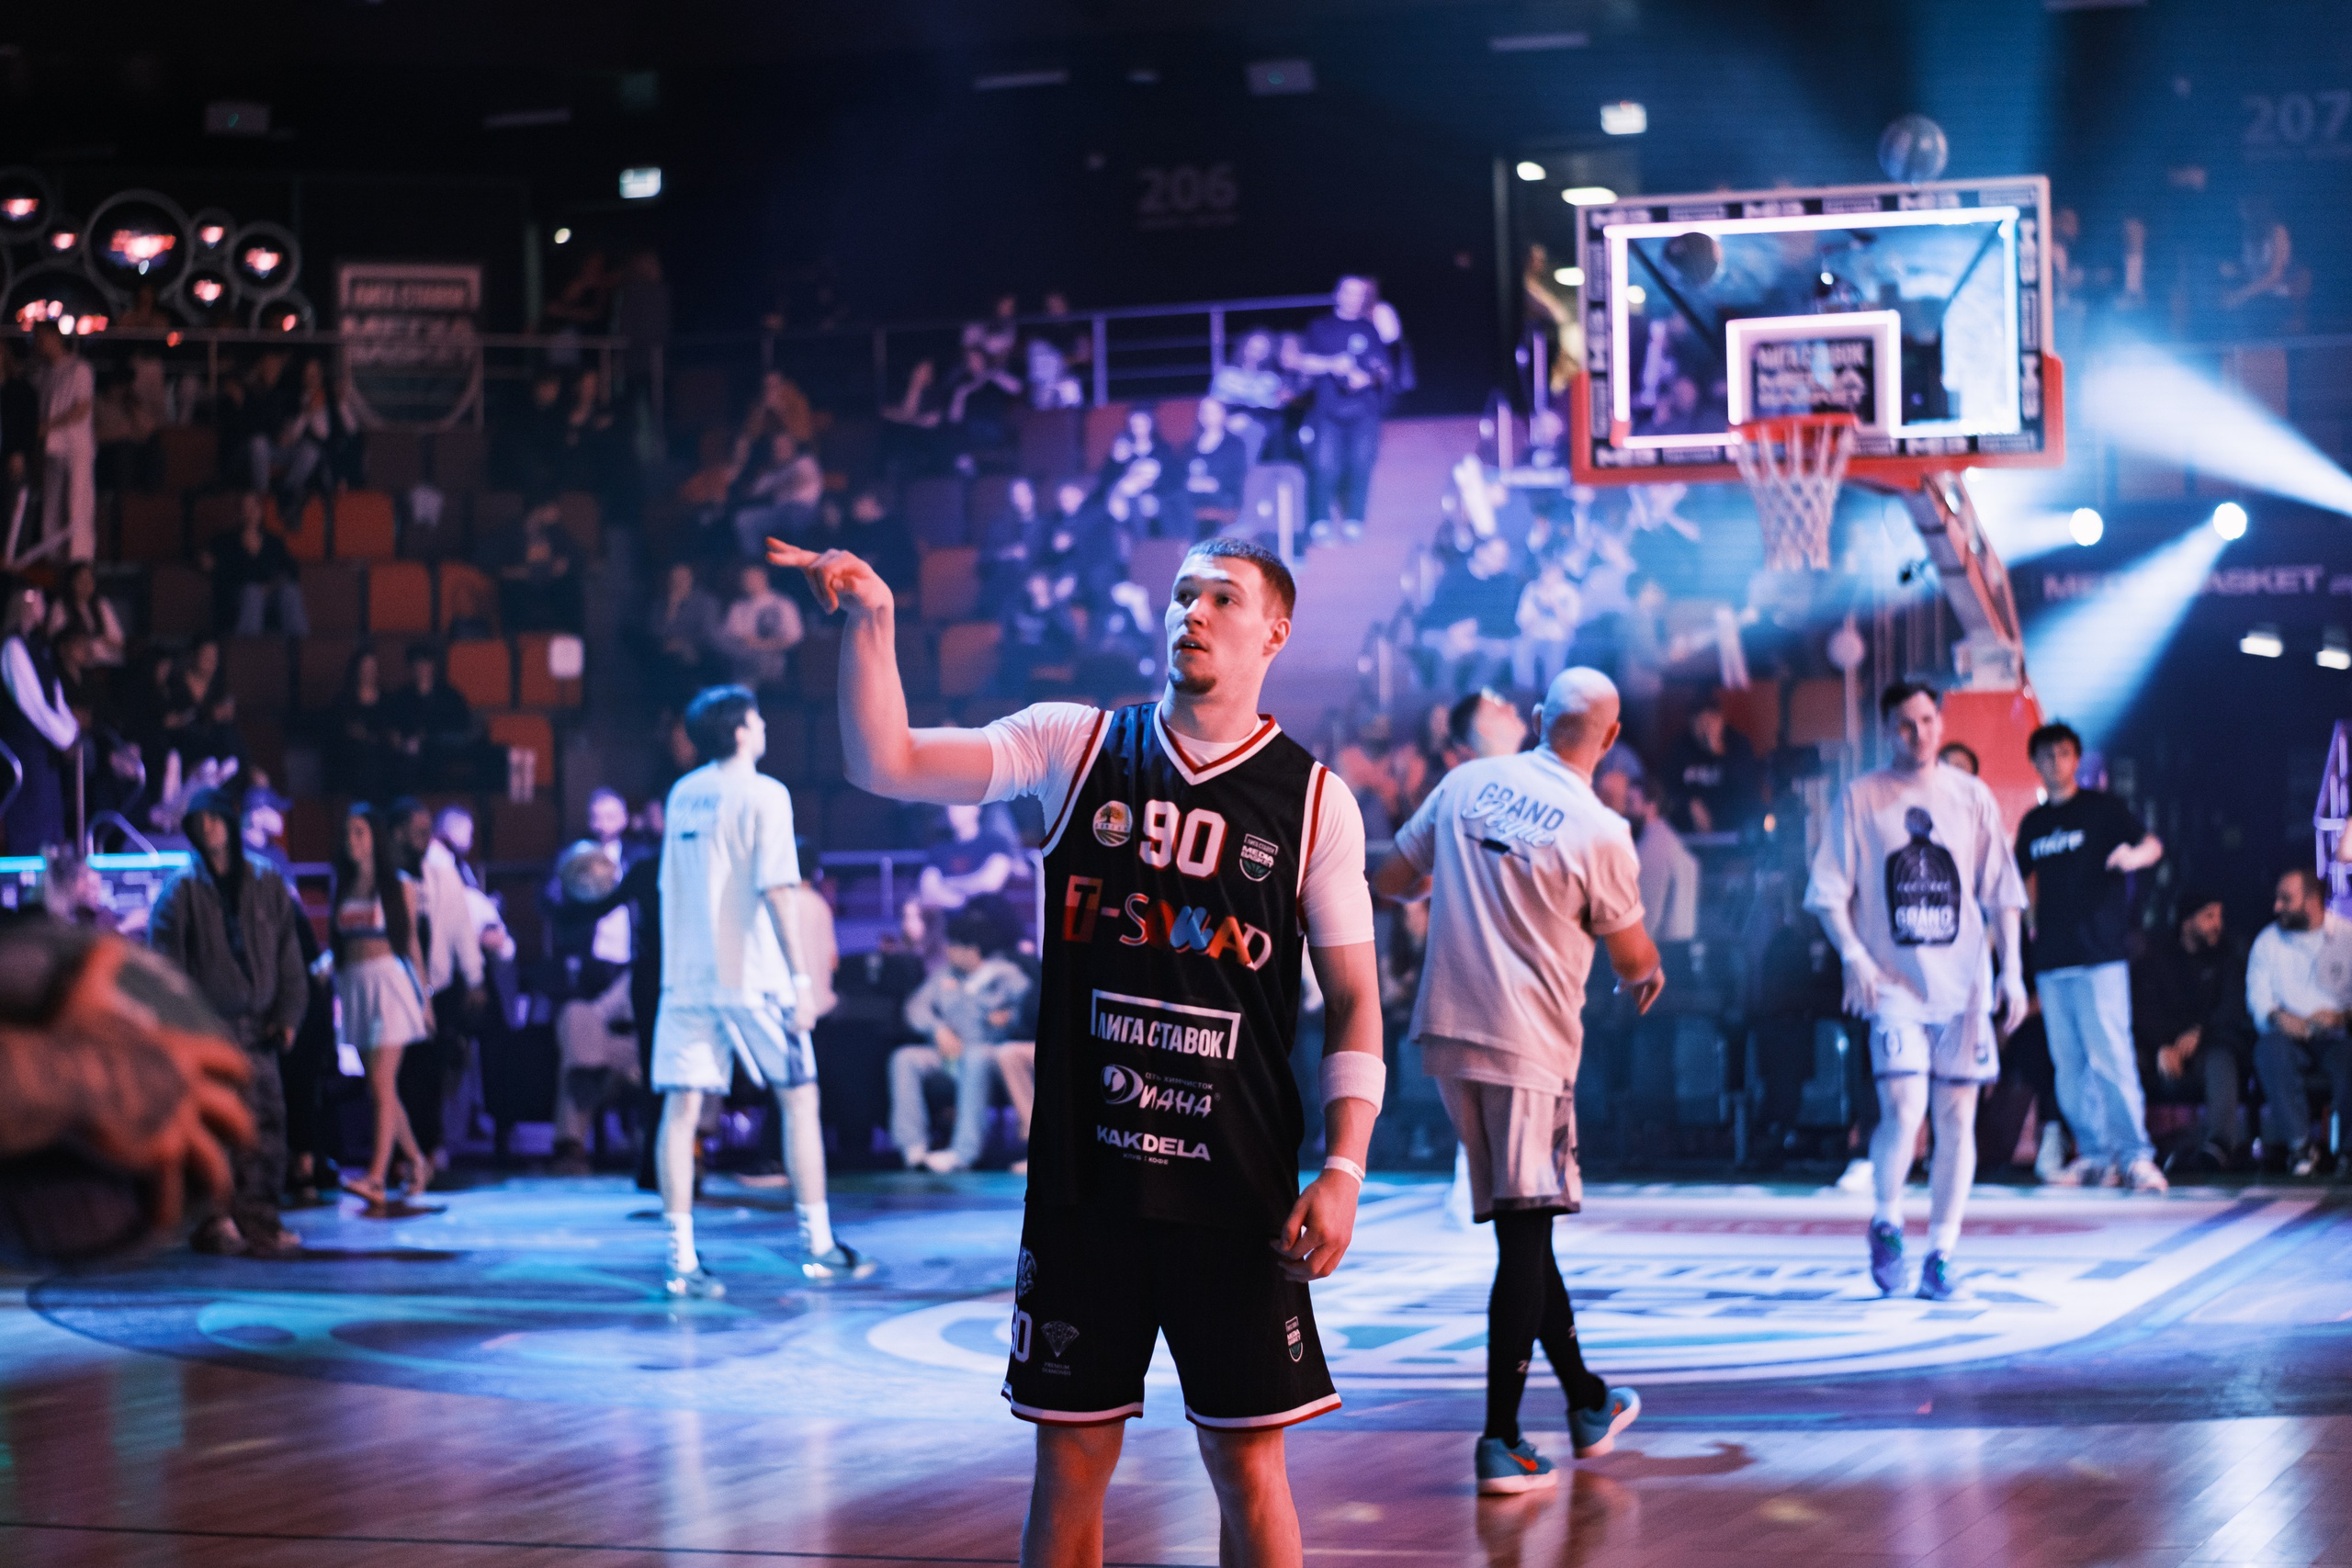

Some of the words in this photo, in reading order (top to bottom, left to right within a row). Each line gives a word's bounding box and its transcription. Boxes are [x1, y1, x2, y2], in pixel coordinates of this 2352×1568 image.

[2242, 91, 2350, 143] 207
[1137, 163, 1238, 212] 206
[1473, 783, 1565, 830] GRAND
[1139, 799, 1227, 879] 90
[1098, 1011, 1144, 1045] ЛИГА
[1148, 1021, 1225, 1058] СТАВОК
[1096, 1124, 1211, 1161] KAKDELA
